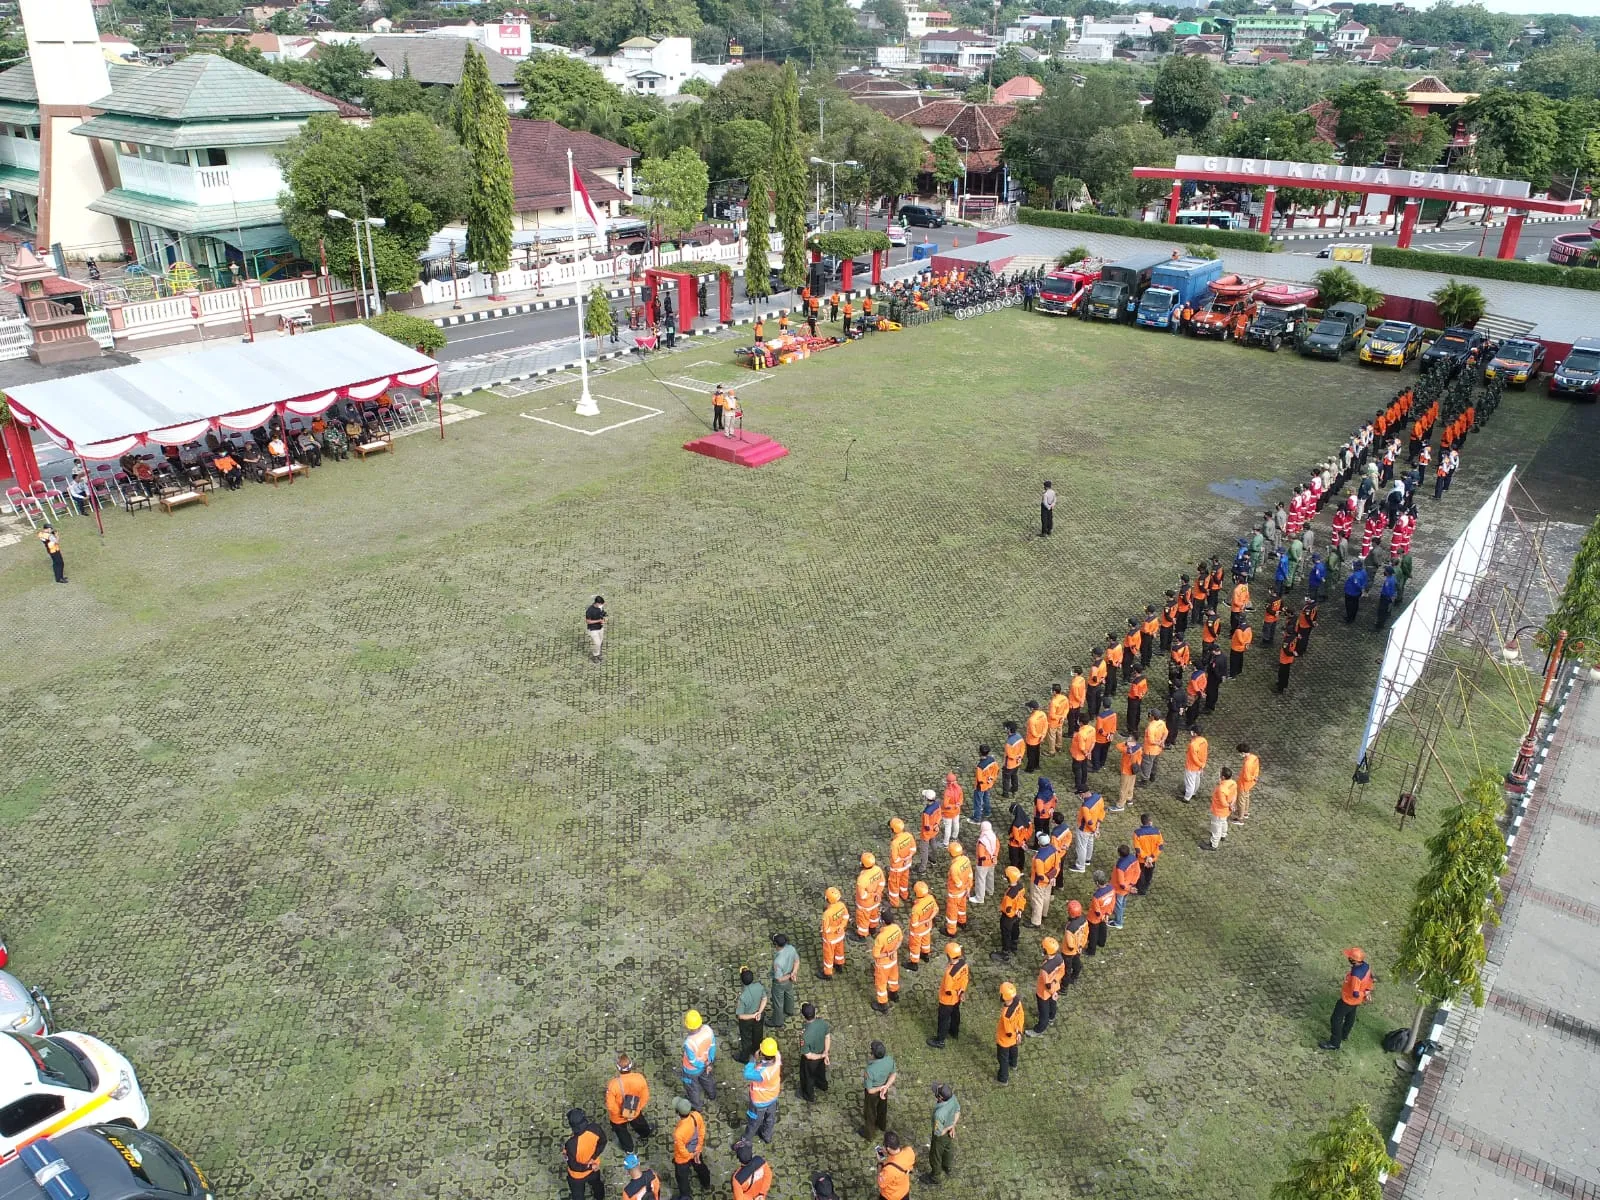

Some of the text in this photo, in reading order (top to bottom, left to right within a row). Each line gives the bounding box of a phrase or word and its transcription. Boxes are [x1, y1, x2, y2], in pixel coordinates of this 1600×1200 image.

[1204, 157, 1504, 196] GIRI KRIDA BAKTI
[108, 1137, 141, 1168] POLISI
